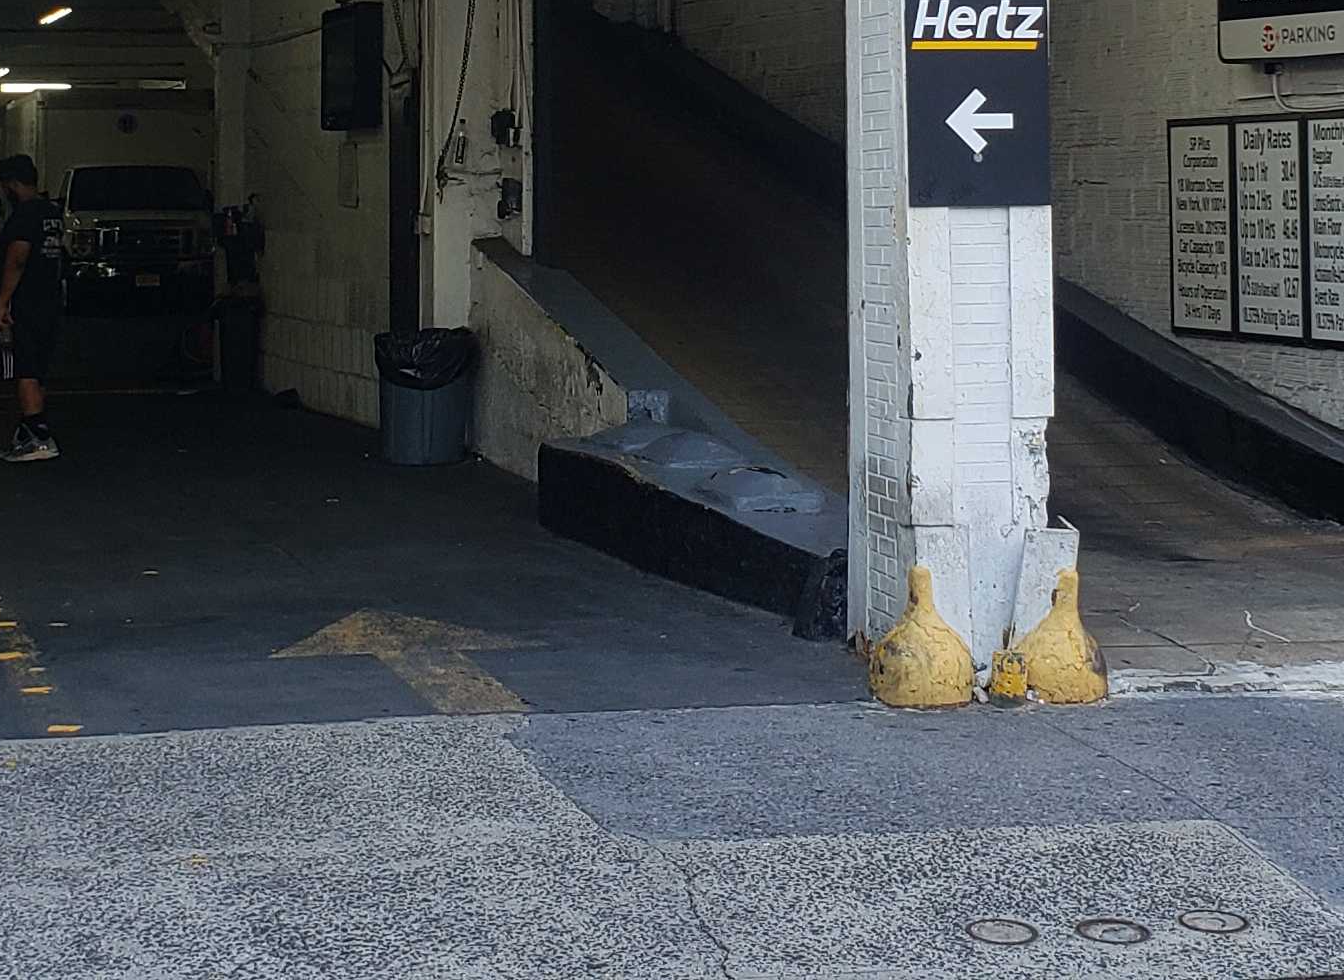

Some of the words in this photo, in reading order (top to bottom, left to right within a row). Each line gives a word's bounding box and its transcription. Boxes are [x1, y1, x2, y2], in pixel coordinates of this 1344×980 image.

[912, 0, 1042, 39] Hertz
[1281, 25, 1336, 44] PARKING
[1243, 128, 1265, 155] Daily
[1267, 128, 1292, 149] Rates
[1239, 161, 1248, 188] Up
[1248, 164, 1255, 181] to
[1240, 190, 1248, 216] Up
[1249, 192, 1255, 210] to
[1261, 190, 1272, 210] Hrs
[1240, 218, 1248, 245] Up
[1249, 221, 1255, 239] to
[1265, 219, 1276, 239] Hrs
[1240, 246, 1254, 267] Max
[1254, 249, 1261, 267] to
[1261, 246, 1269, 268] 24
[1269, 247, 1281, 268] Hrs
[1313, 241, 1344, 264] Motorcycle
[1178, 259, 1195, 276] Bicycle
